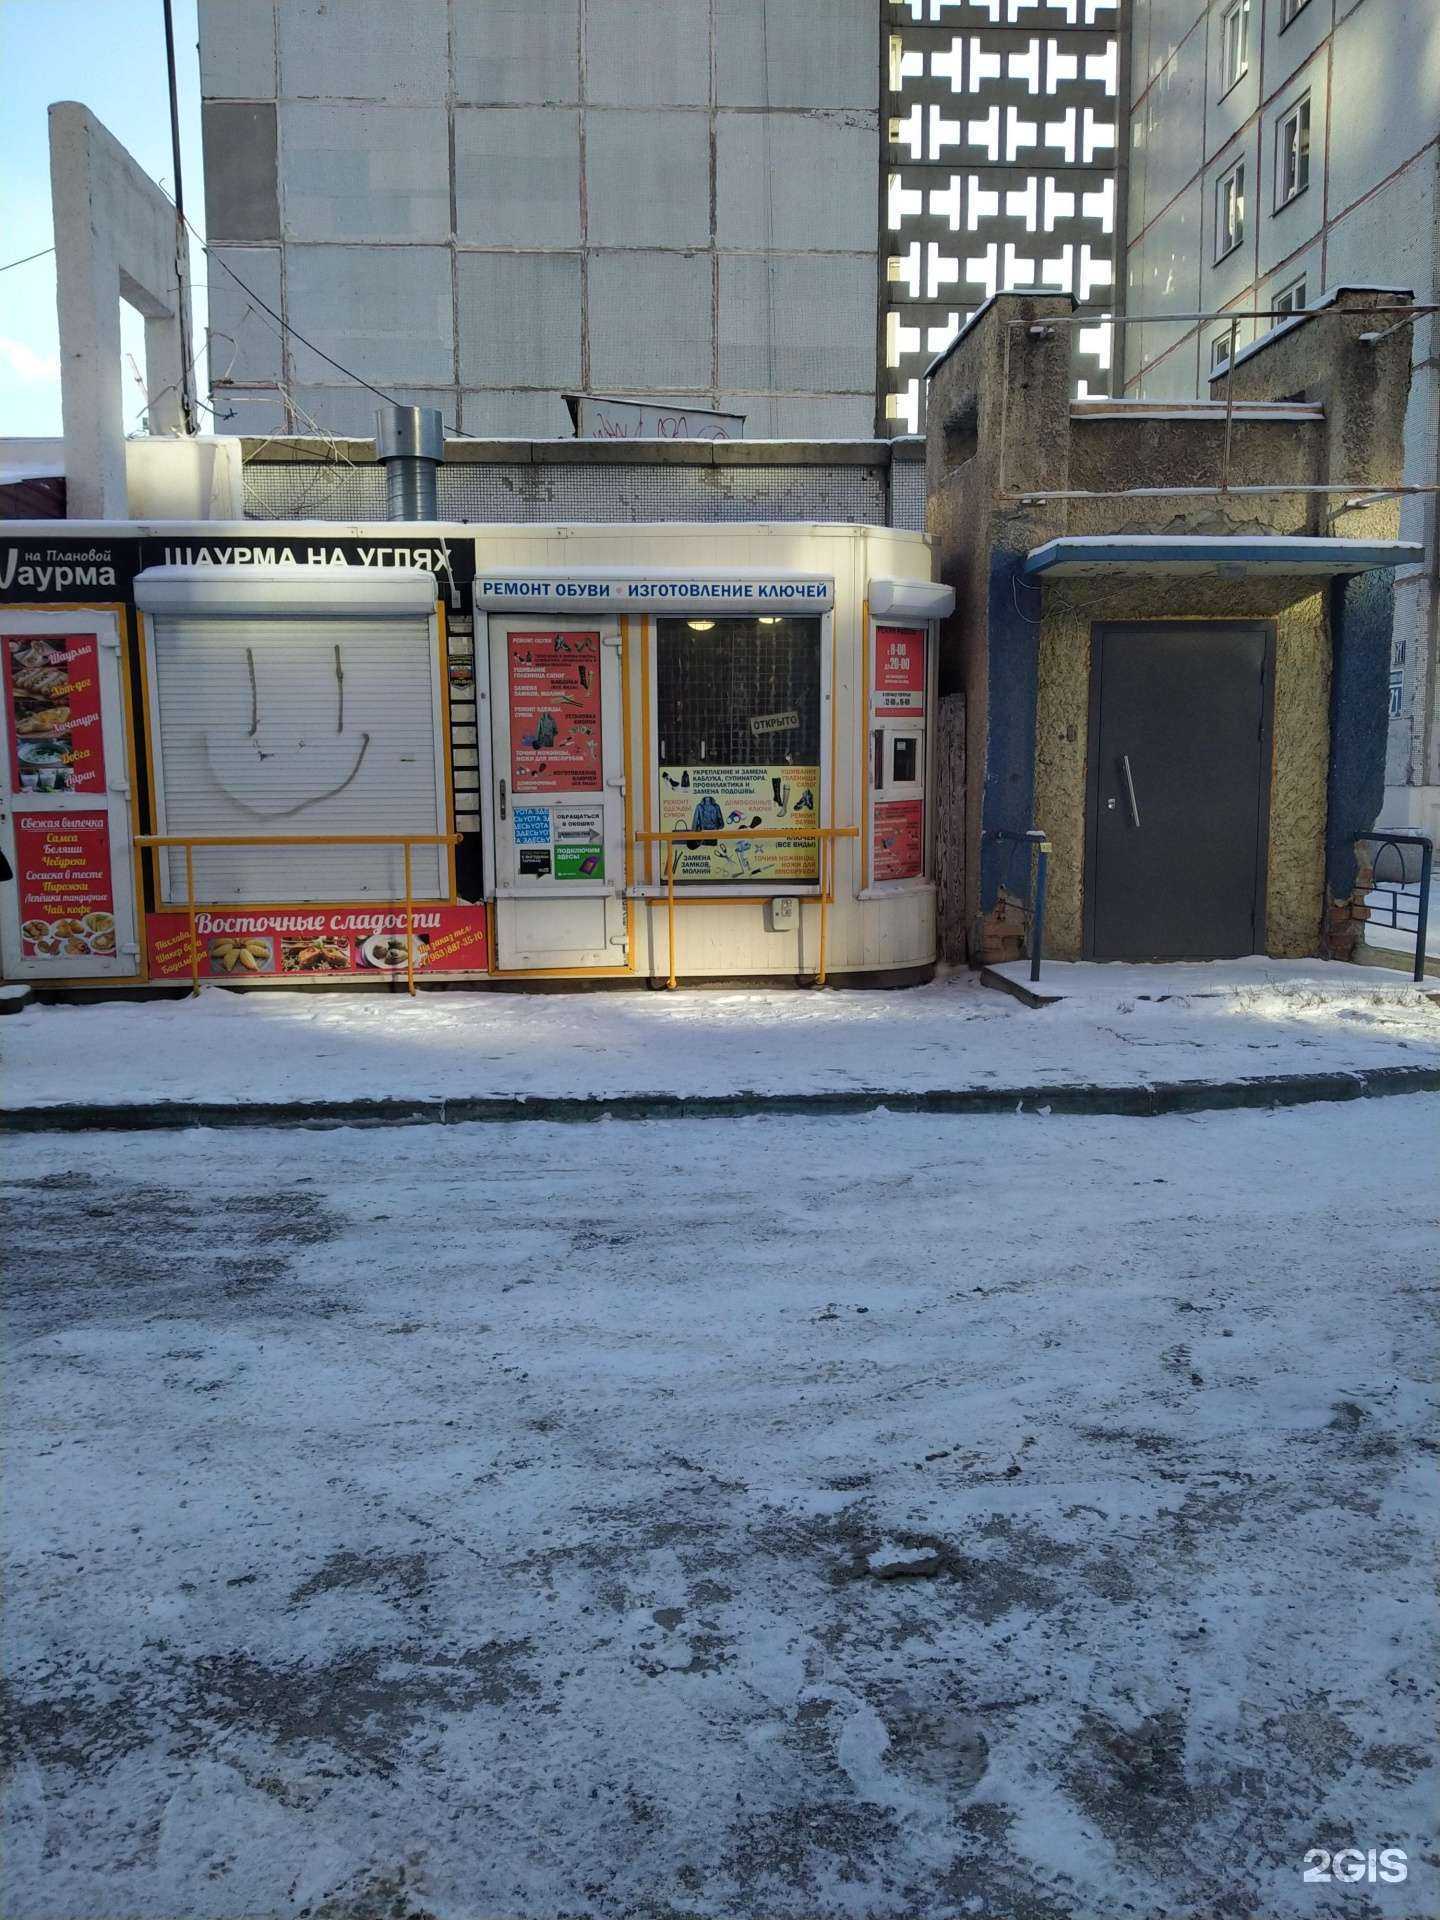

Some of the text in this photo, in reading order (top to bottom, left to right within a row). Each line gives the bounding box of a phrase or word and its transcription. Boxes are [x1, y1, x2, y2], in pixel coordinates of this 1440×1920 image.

[25, 549, 112, 562] на Плановой
[164, 547, 298, 566] ШАУРМА
[307, 547, 349, 566] НА
[483, 582, 827, 599] РЕМОНТ ОБУВИ ИЗГОТОВЛЕНИЕ КЛЮЧЕЙ
[50, 645, 92, 664] Шаурма
[890, 657, 910, 670] 20-00
[753, 715, 798, 730] ОТКРЫТО
[20, 817, 104, 829] Свежая выпечка
[46, 833, 79, 843] Самса
[43, 844, 83, 854] Беляши
[42, 856, 86, 869] Чебуреки
[42, 882, 88, 893] Пирожки
[66, 904, 92, 914] кофе
[195, 911, 441, 935] Восточные сладости
